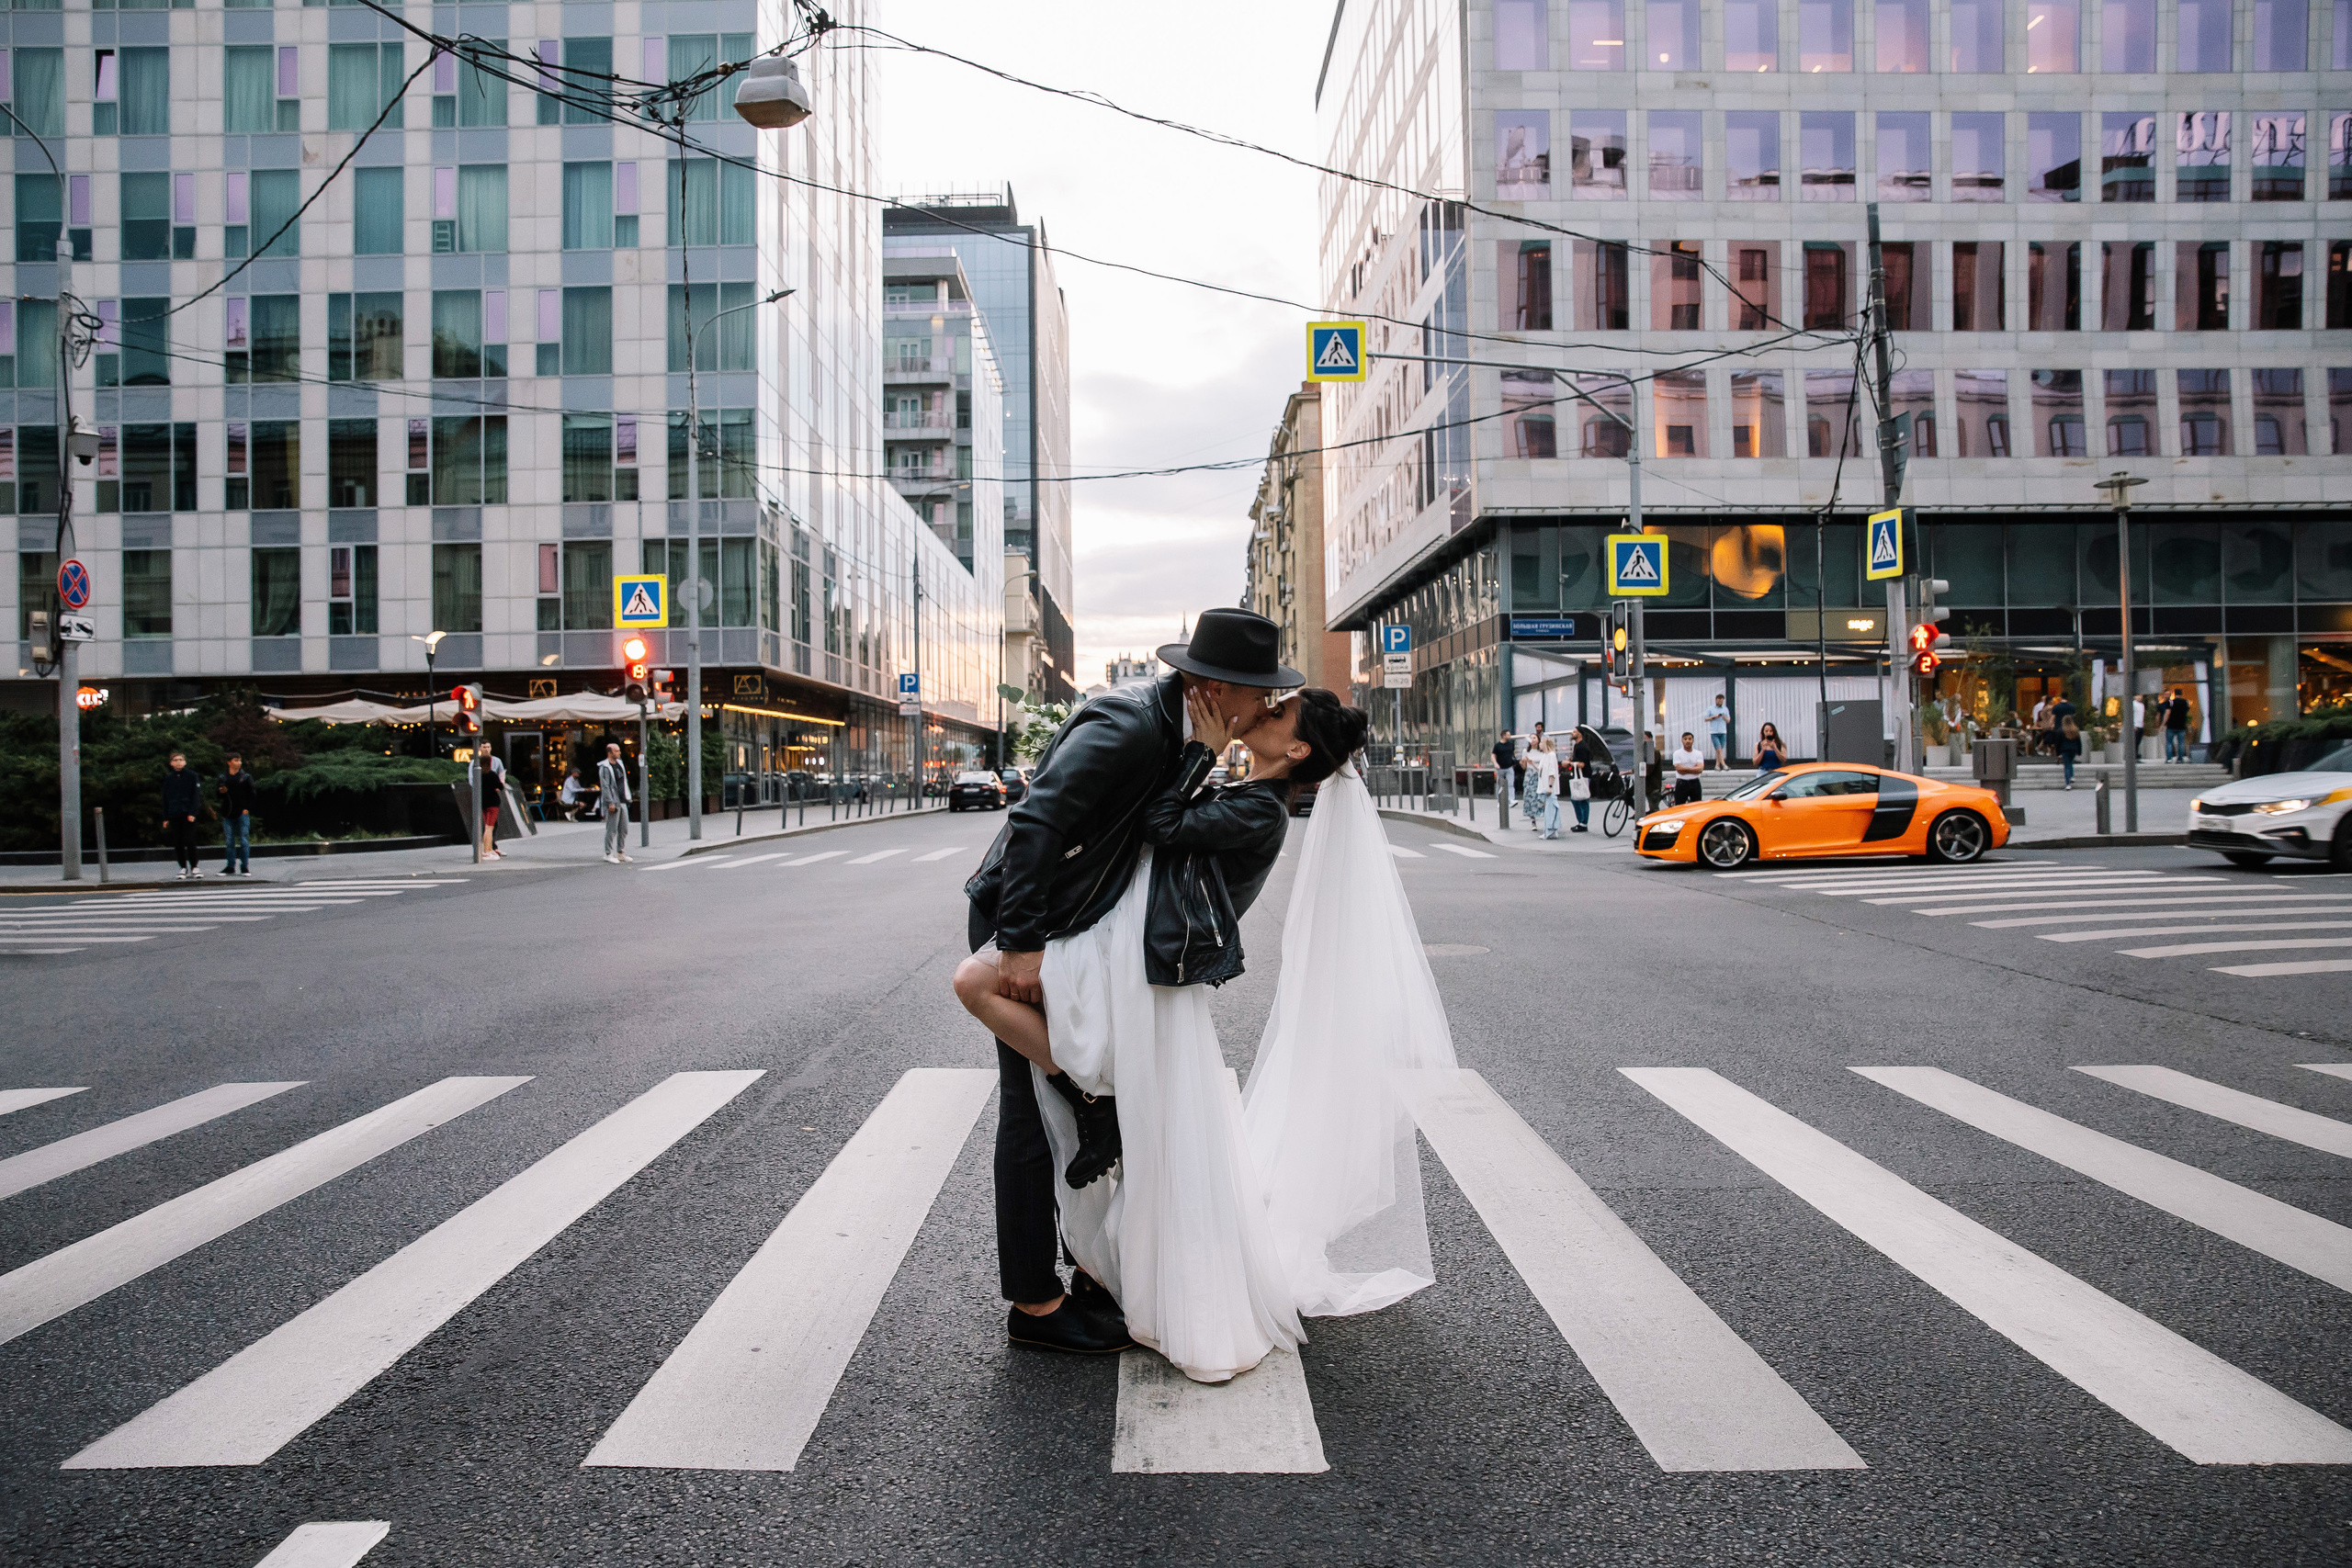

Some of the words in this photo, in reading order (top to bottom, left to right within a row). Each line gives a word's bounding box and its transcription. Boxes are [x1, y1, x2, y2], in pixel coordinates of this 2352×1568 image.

[1390, 627, 1407, 650] P
[632, 663, 644, 679] 19
[1920, 656, 1932, 672] 2
[904, 674, 916, 692] P
